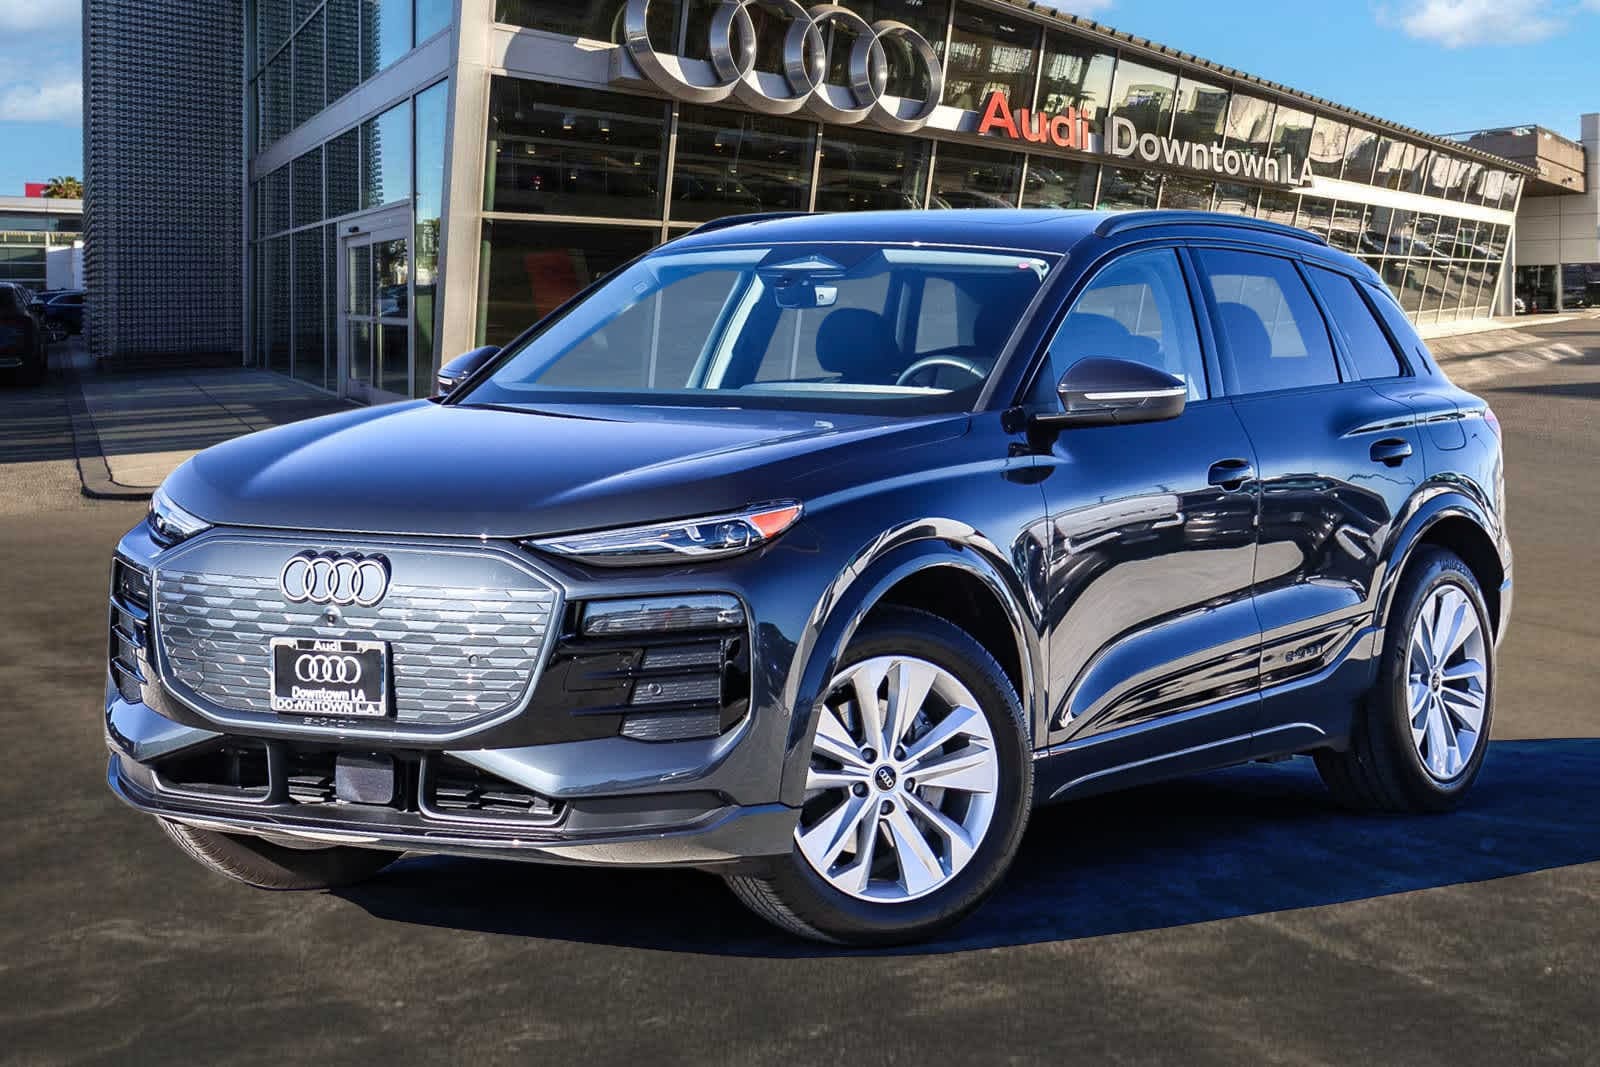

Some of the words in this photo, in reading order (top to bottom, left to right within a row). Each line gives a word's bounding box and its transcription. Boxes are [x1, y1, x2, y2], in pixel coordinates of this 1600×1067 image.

[978, 91, 1089, 150] Audi
[1112, 116, 1279, 182] Downtown
[1287, 153, 1315, 188] LA
[291, 686, 350, 702] Downtown
[351, 688, 366, 703] LA
[276, 699, 353, 714] DOWNTOWN
